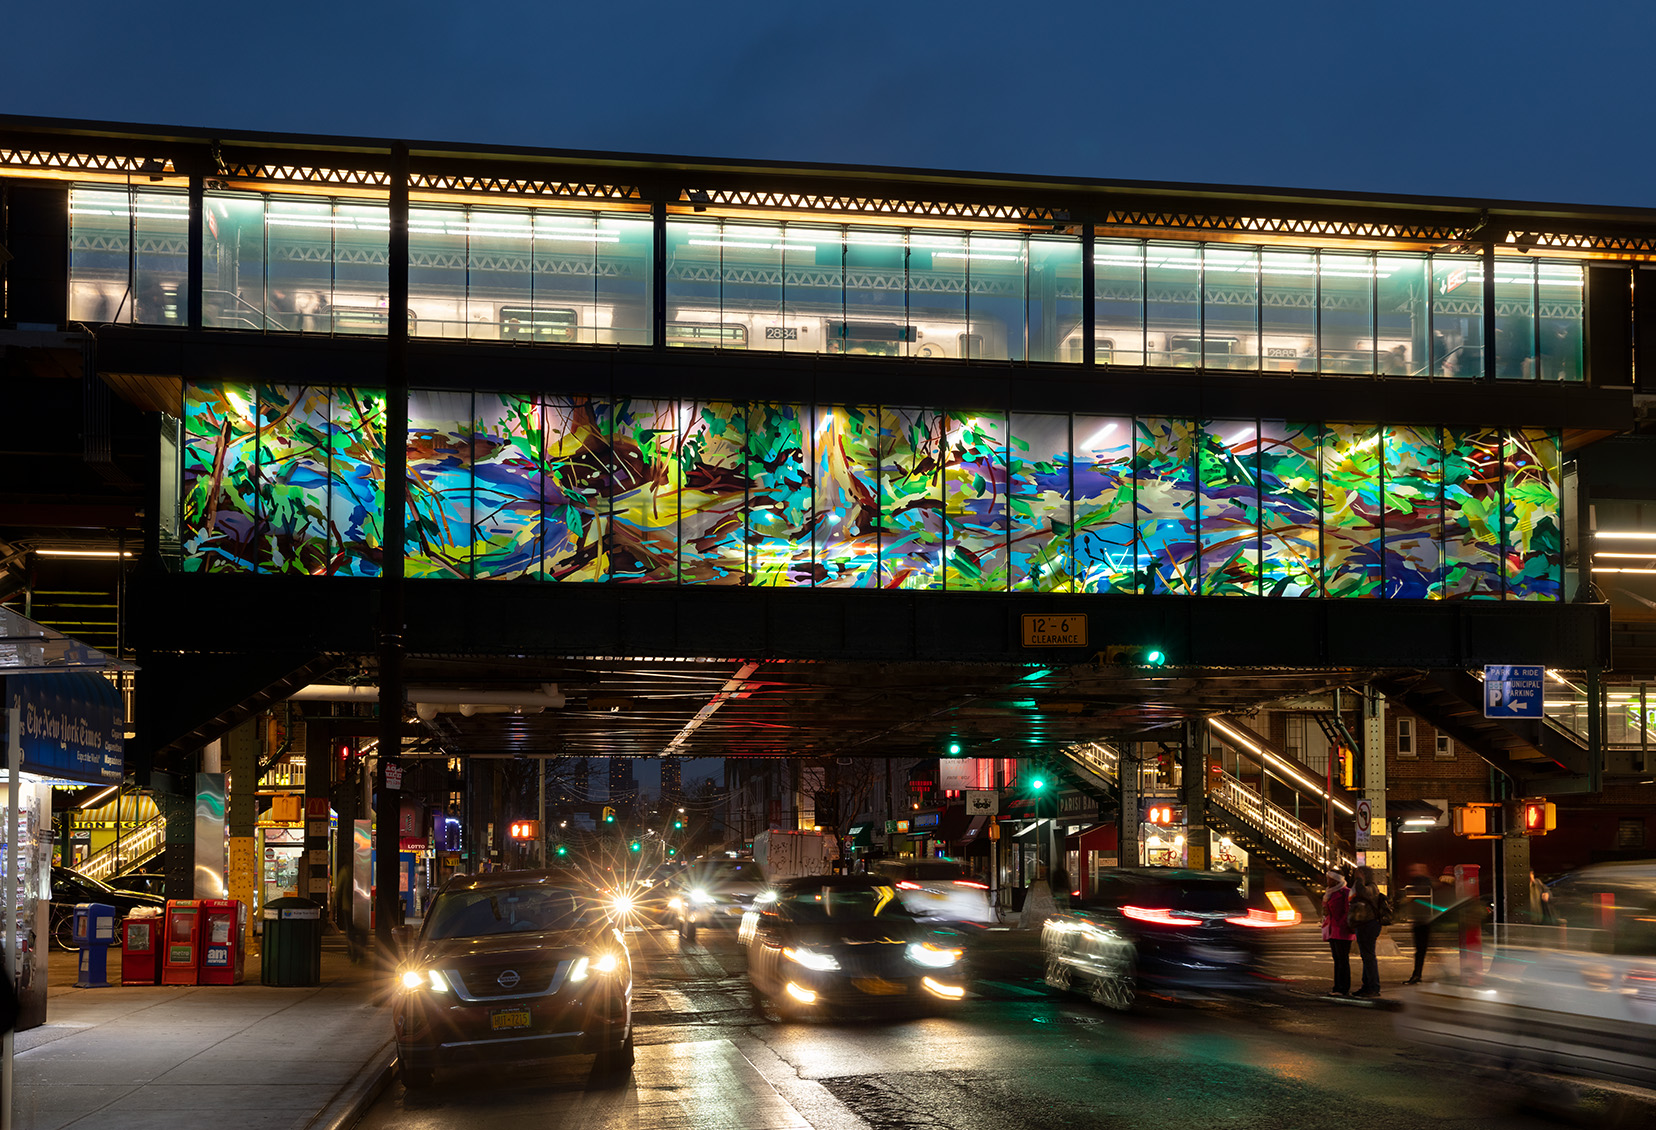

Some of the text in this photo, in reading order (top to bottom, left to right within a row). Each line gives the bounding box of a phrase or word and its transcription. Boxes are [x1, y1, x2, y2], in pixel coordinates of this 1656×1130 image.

[1032, 635, 1078, 644] CLEARANCE
[1506, 689, 1534, 697] PARKING
[27, 702, 102, 751] The New York Times
[1060, 796, 1081, 813] PARISI
